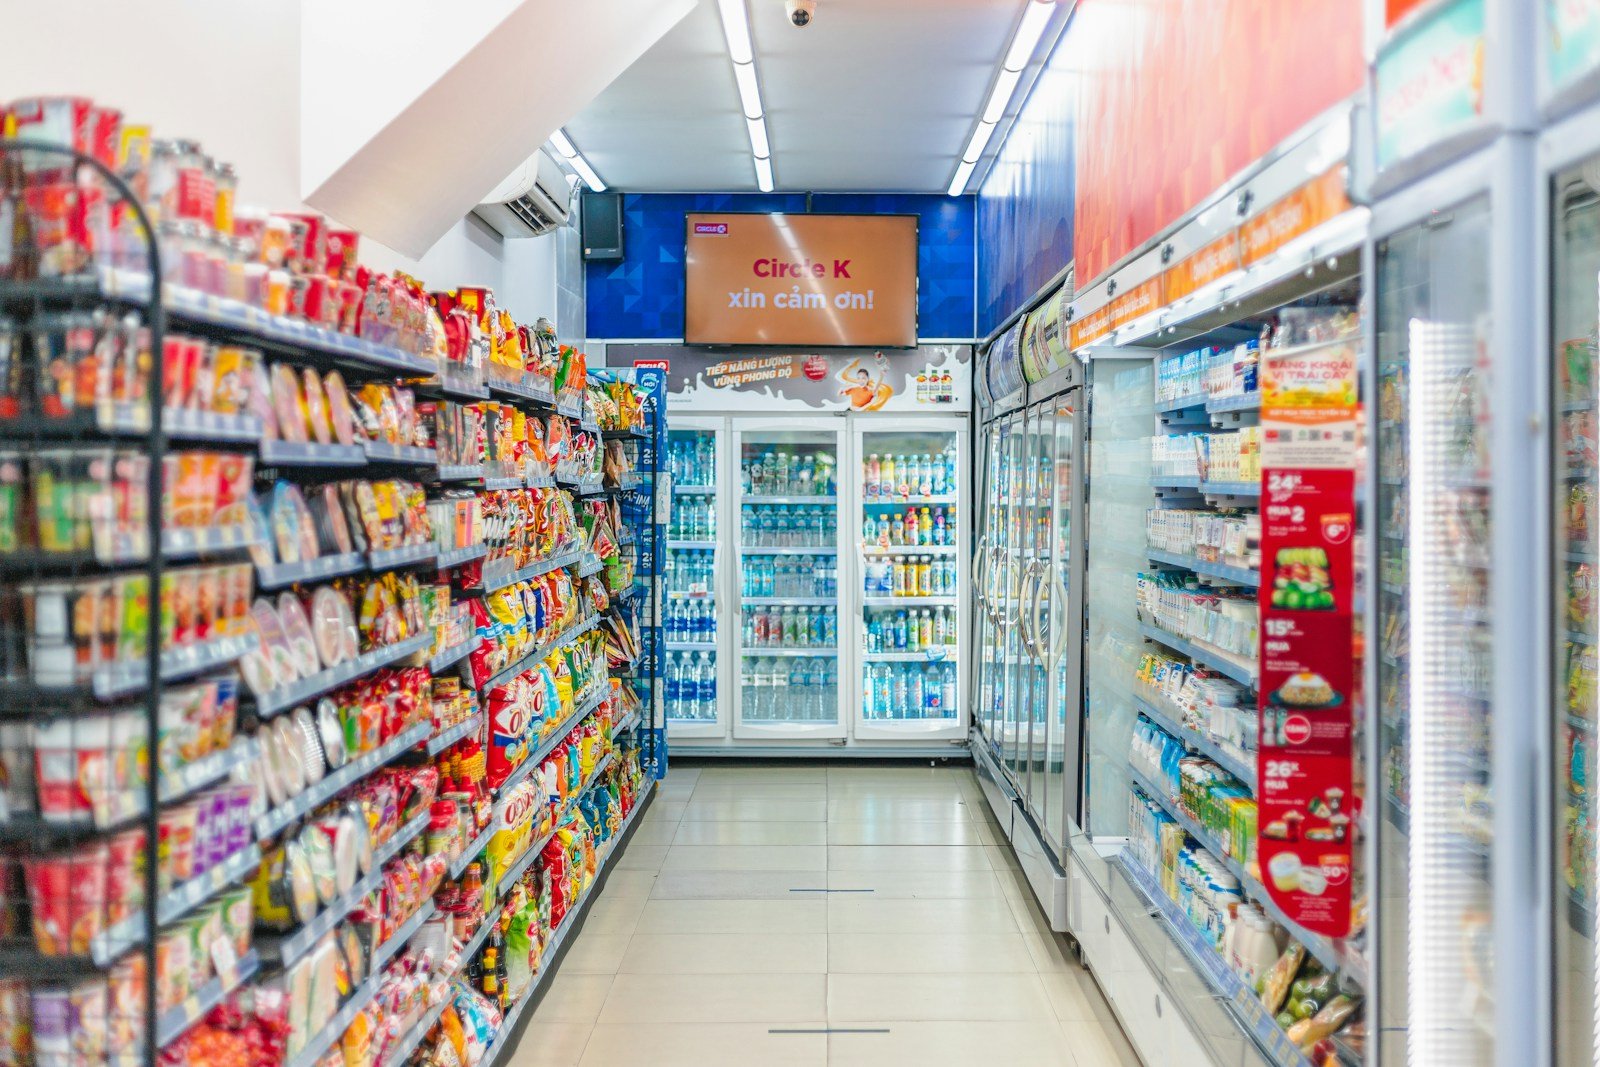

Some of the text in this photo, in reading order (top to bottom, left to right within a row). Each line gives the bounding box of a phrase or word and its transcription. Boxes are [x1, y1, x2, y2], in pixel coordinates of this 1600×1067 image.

[696, 225, 717, 233] CIRCLE
[753, 258, 851, 278] Circle K
[728, 285, 874, 309] xin cảm ơn!
[706, 362, 728, 376] TIẾP
[742, 370, 776, 383] PHONG
[1291, 505, 1305, 523] 2
